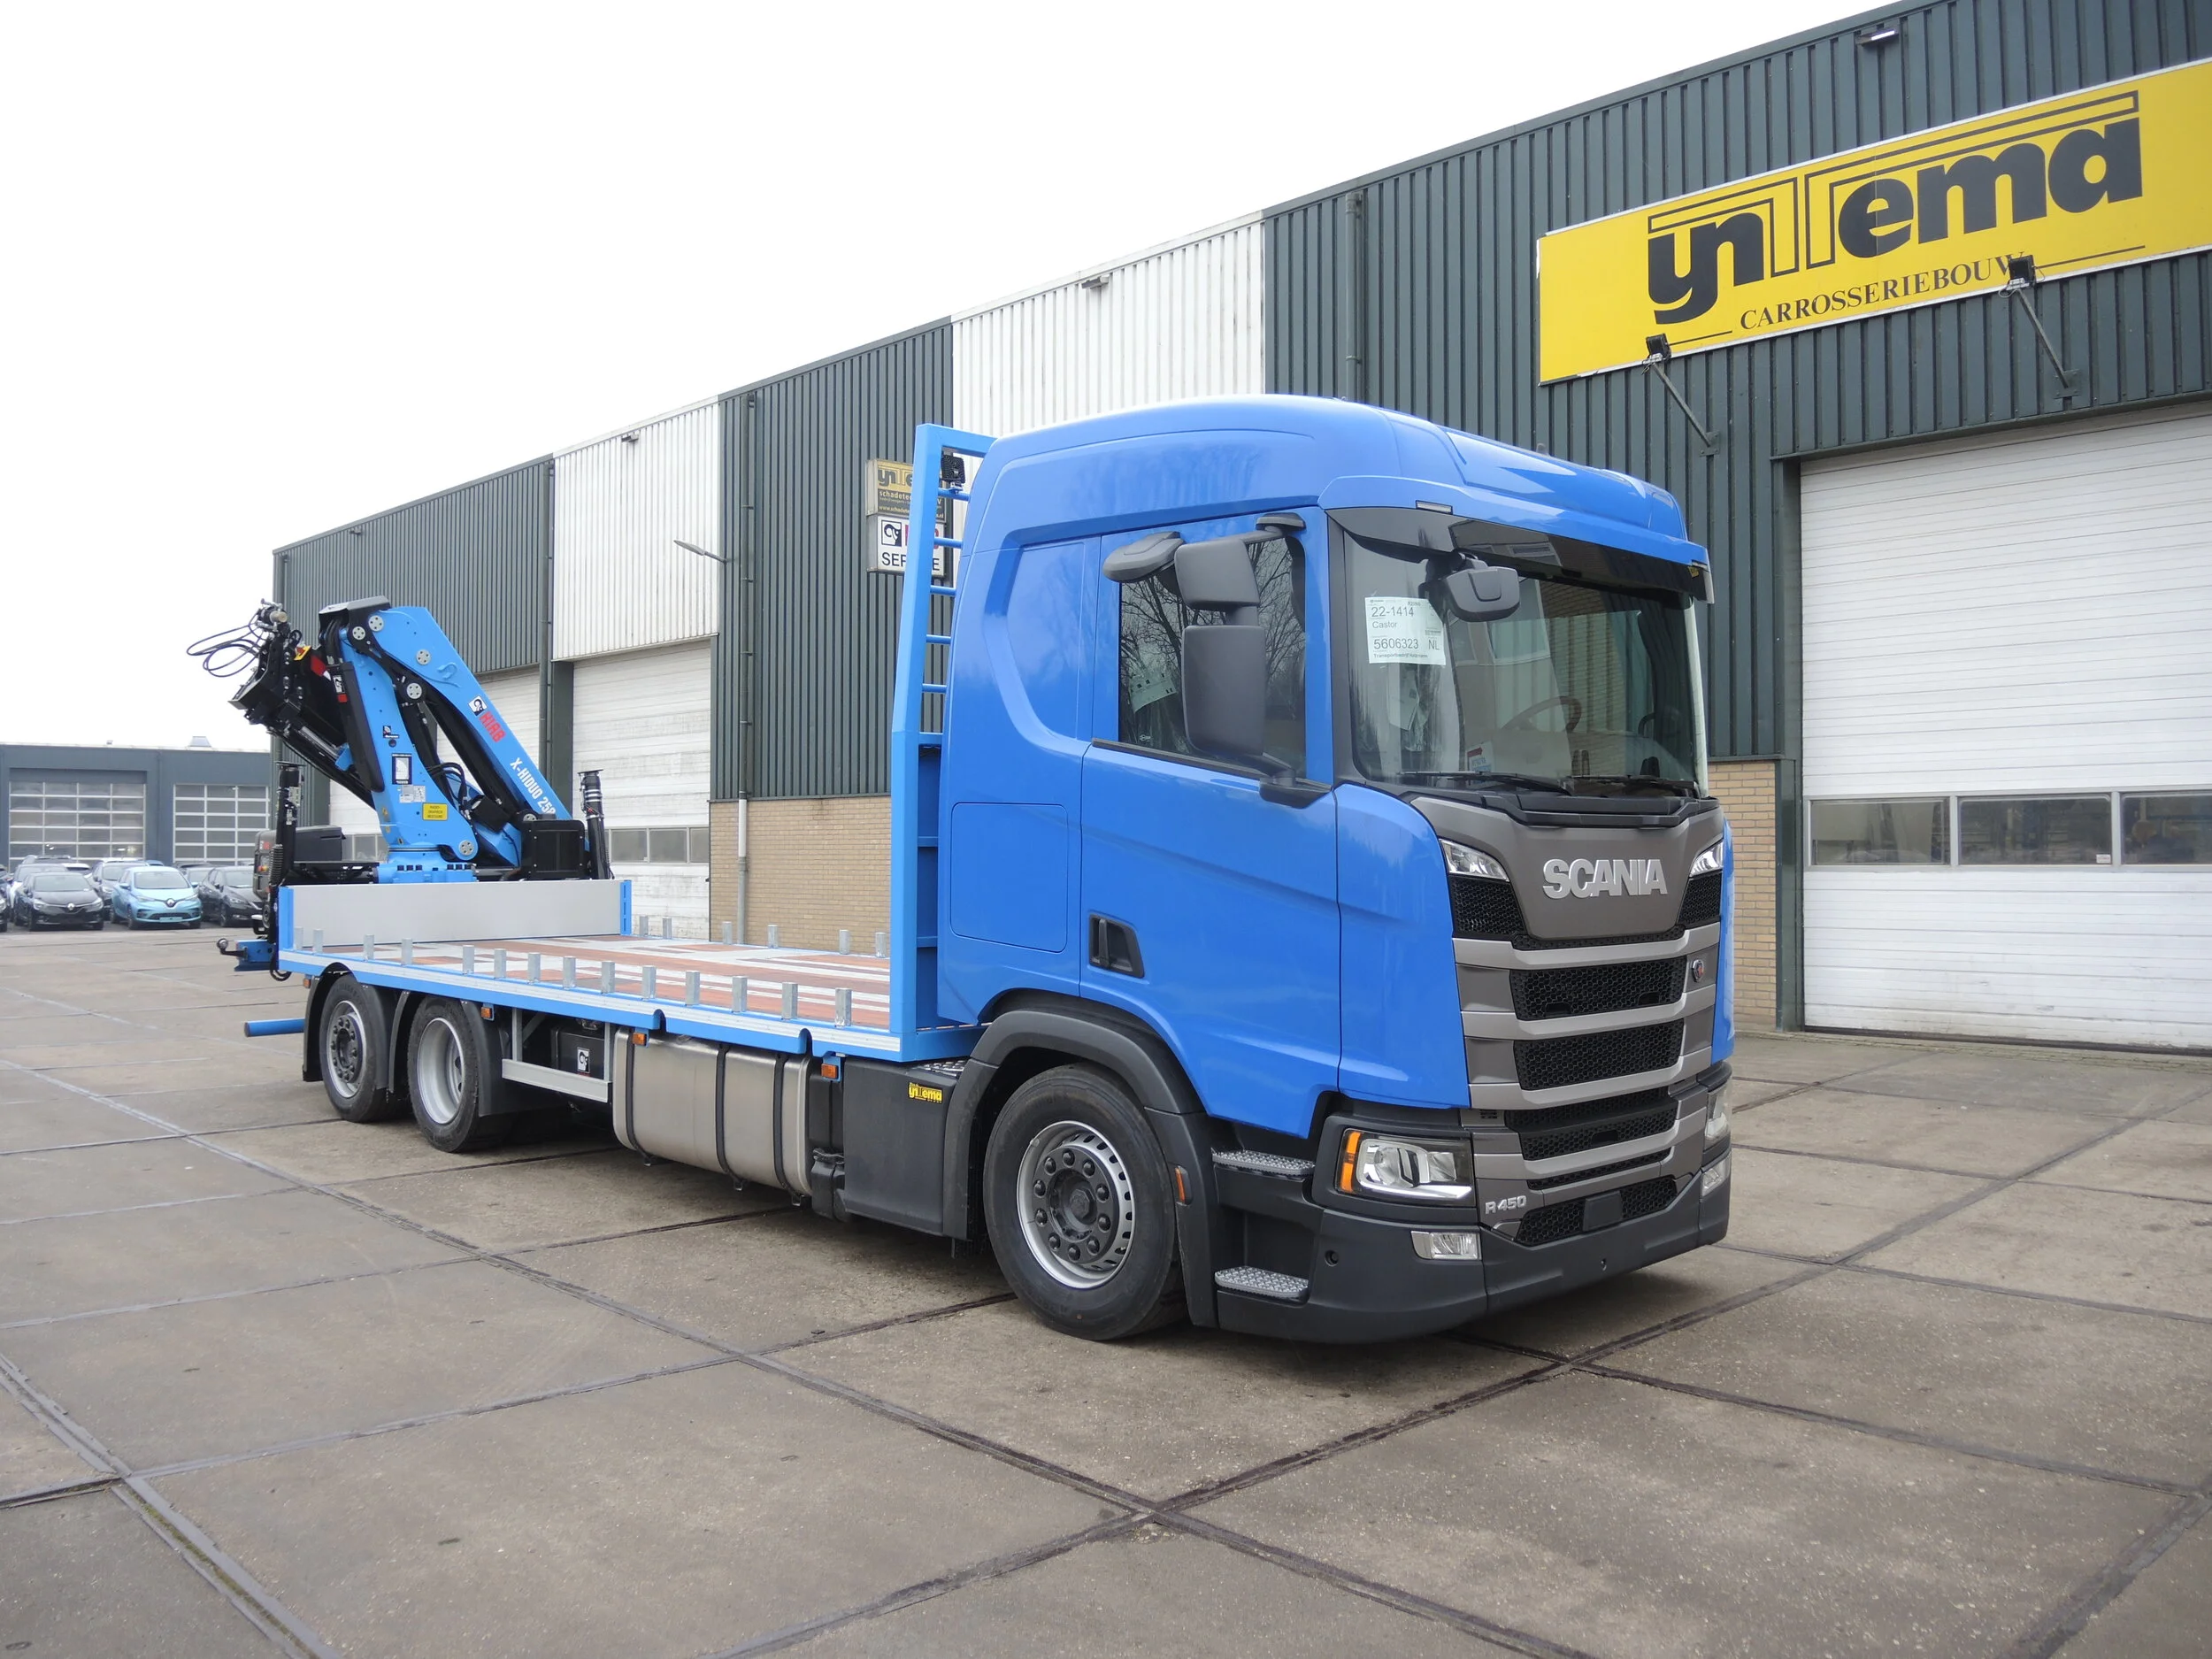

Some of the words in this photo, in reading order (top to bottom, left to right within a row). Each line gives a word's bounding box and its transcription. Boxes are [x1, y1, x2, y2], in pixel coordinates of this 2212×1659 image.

[1371, 606, 1414, 618] 22-1414
[1373, 638, 1419, 649] 5606323
[1428, 639, 1440, 650] NL
[480, 711, 506, 742] HIAB
[1542, 858, 1669, 900] SCANIA
